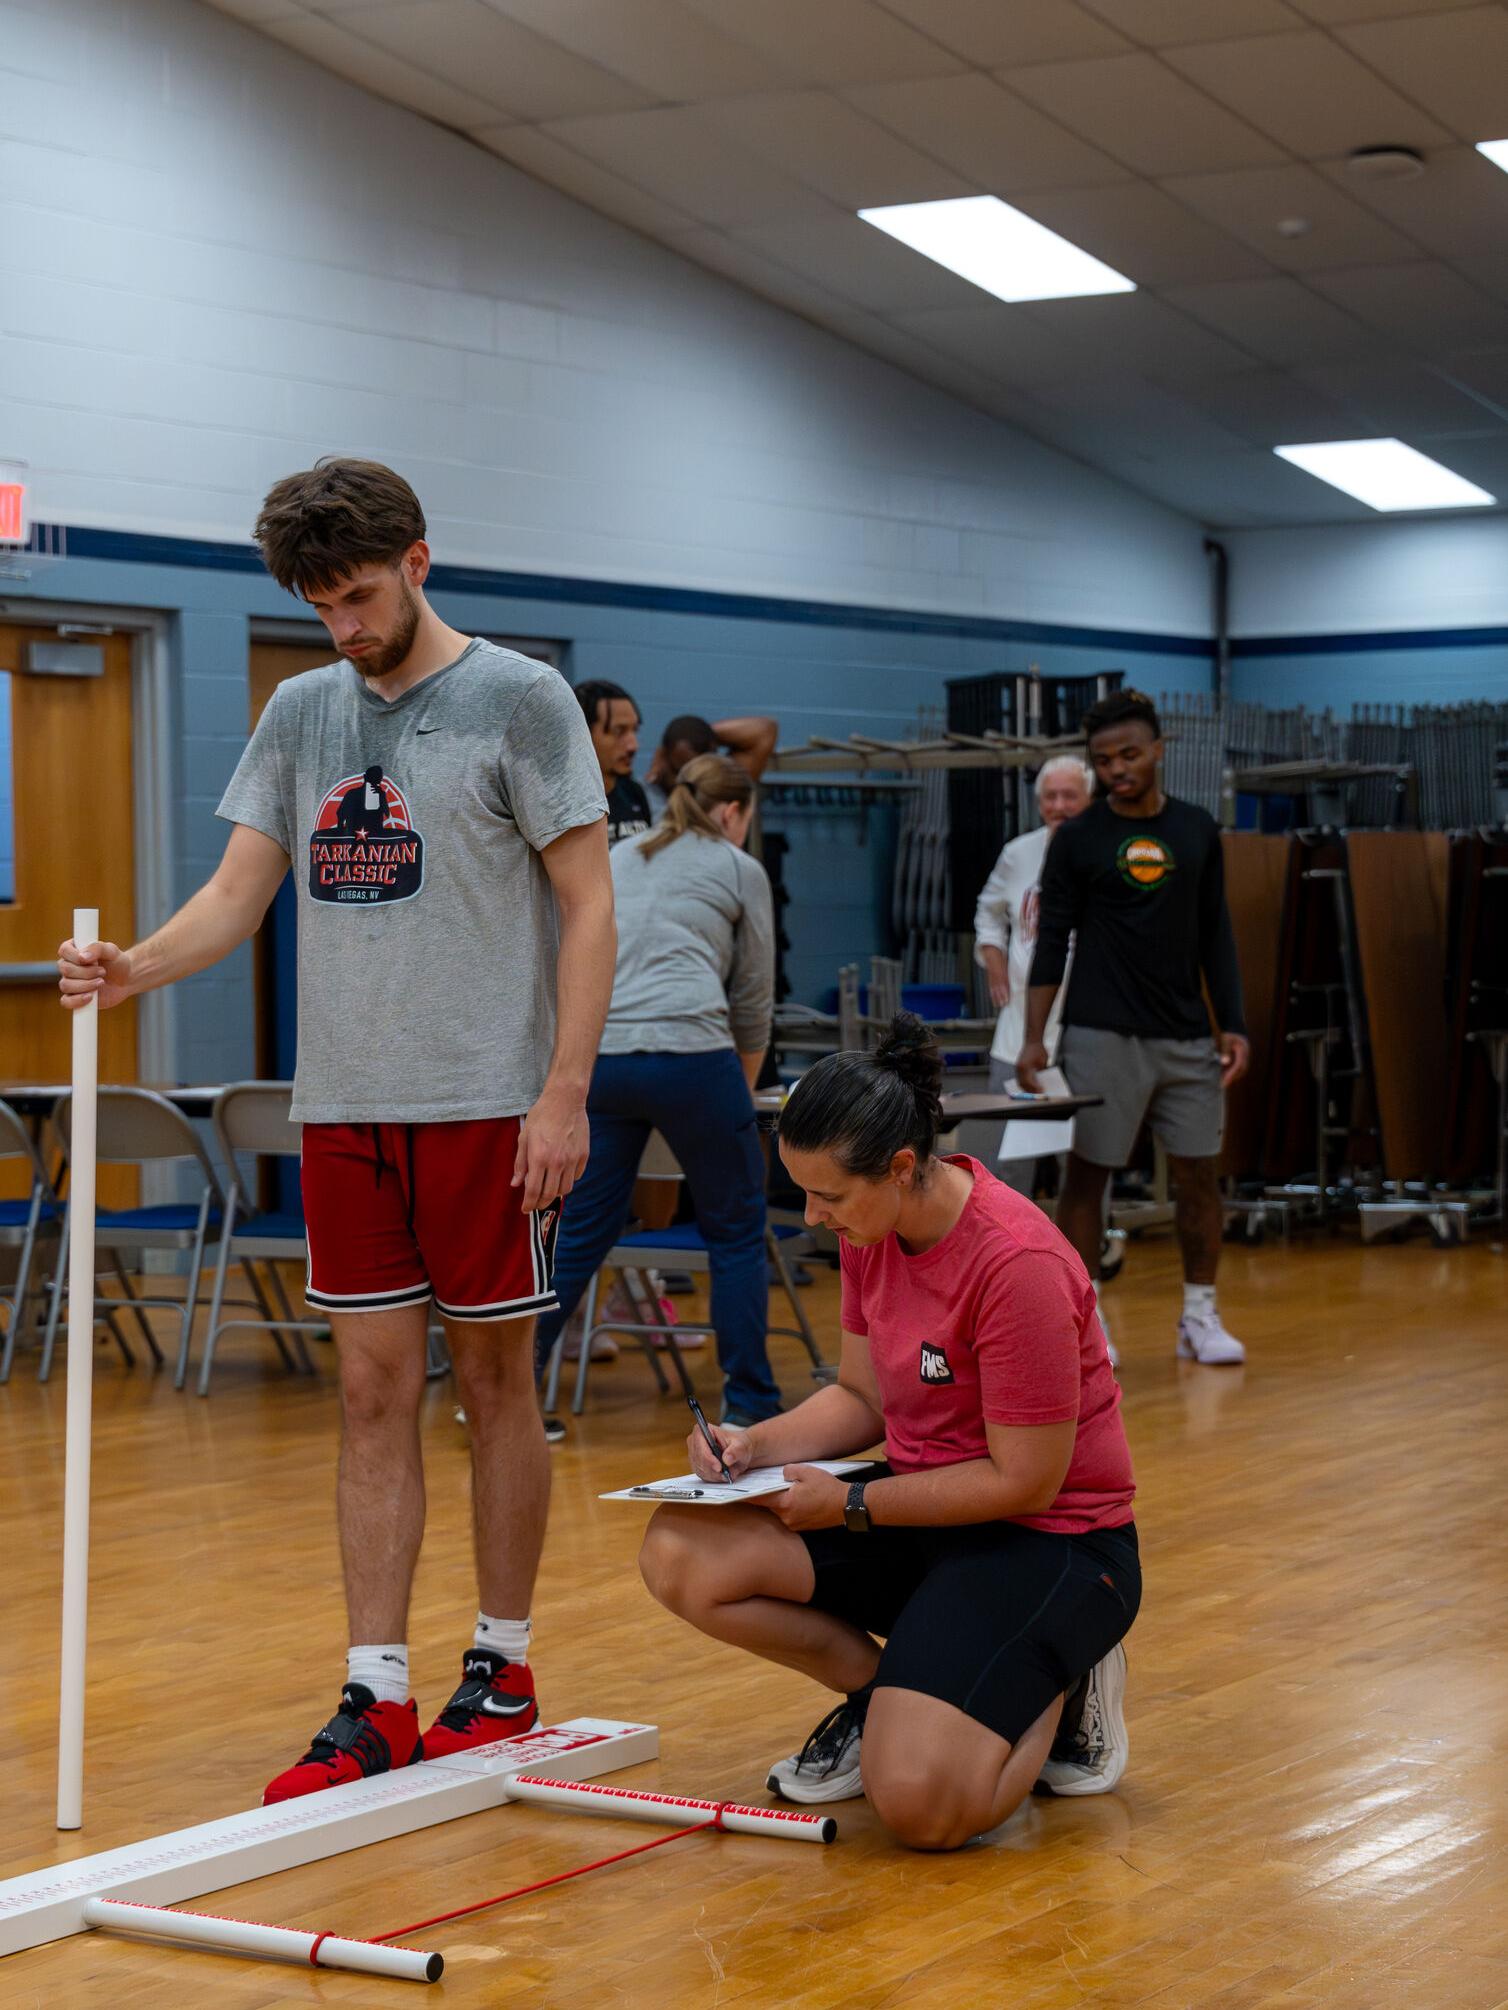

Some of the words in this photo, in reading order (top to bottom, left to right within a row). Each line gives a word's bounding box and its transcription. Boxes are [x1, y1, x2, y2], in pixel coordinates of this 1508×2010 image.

[311, 842, 417, 864] TARKANIAN
[320, 863, 397, 885] CLASSIC
[370, 890, 379, 900] NV
[921, 1349, 950, 1378] FMS
